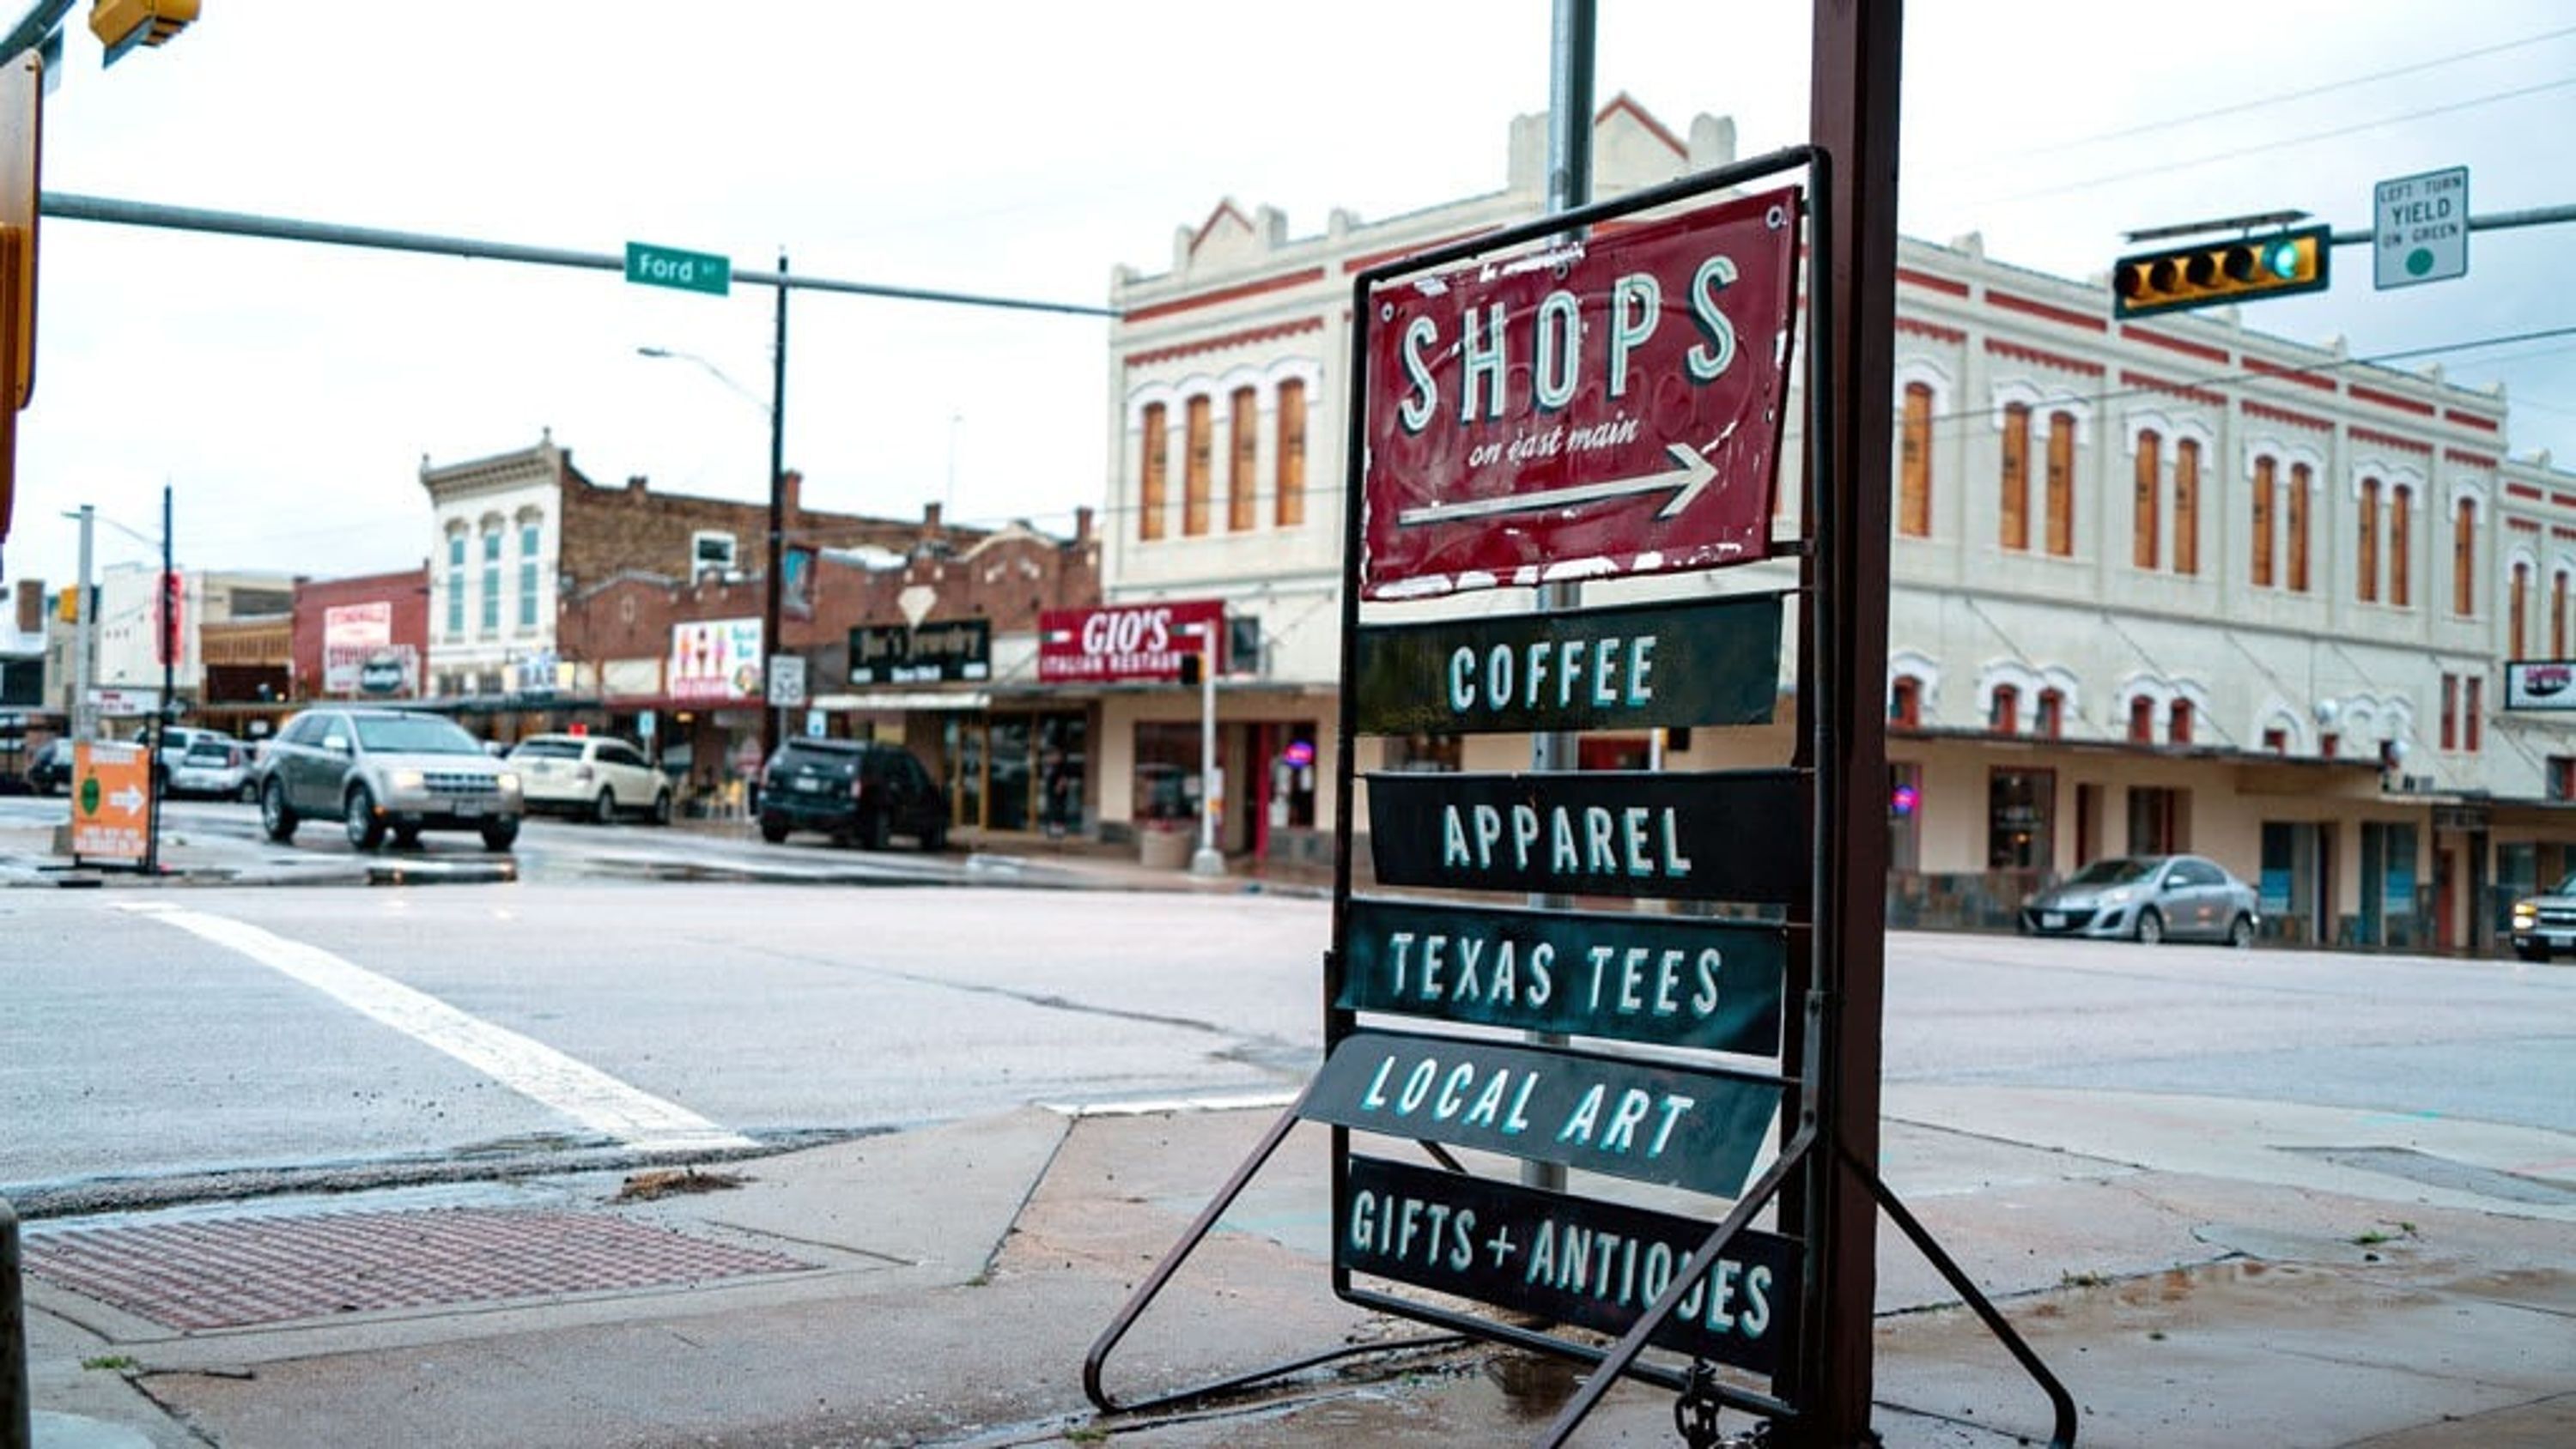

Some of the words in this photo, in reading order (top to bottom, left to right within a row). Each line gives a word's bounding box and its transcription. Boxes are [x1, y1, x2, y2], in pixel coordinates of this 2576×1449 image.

[2379, 184, 2413, 203] LEFT
[2426, 177, 2461, 193] TURN
[2391, 197, 2451, 226] YIELD
[2384, 233, 2403, 248] ON
[2413, 226, 2458, 242] GREEN
[640, 252, 694, 282] Ford
[1398, 255, 1738, 436] SHOPS
[1468, 442, 1502, 467] on
[1507, 424, 1564, 464] east
[1566, 409, 1638, 452] main
[1081, 608, 1172, 655] GIO'S
[1042, 655, 1103, 674] ITALIAN
[1448, 635, 1657, 713] COFFEE
[1443, 804, 1692, 877] APPAREL
[1388, 932, 1556, 1008] TEXAS
[1587, 947, 1722, 1019] TEES
[1361, 1056, 1540, 1134] LOCAL
[1557, 1084, 1695, 1158] ART
[1351, 1190, 1475, 1272] GIFTS
